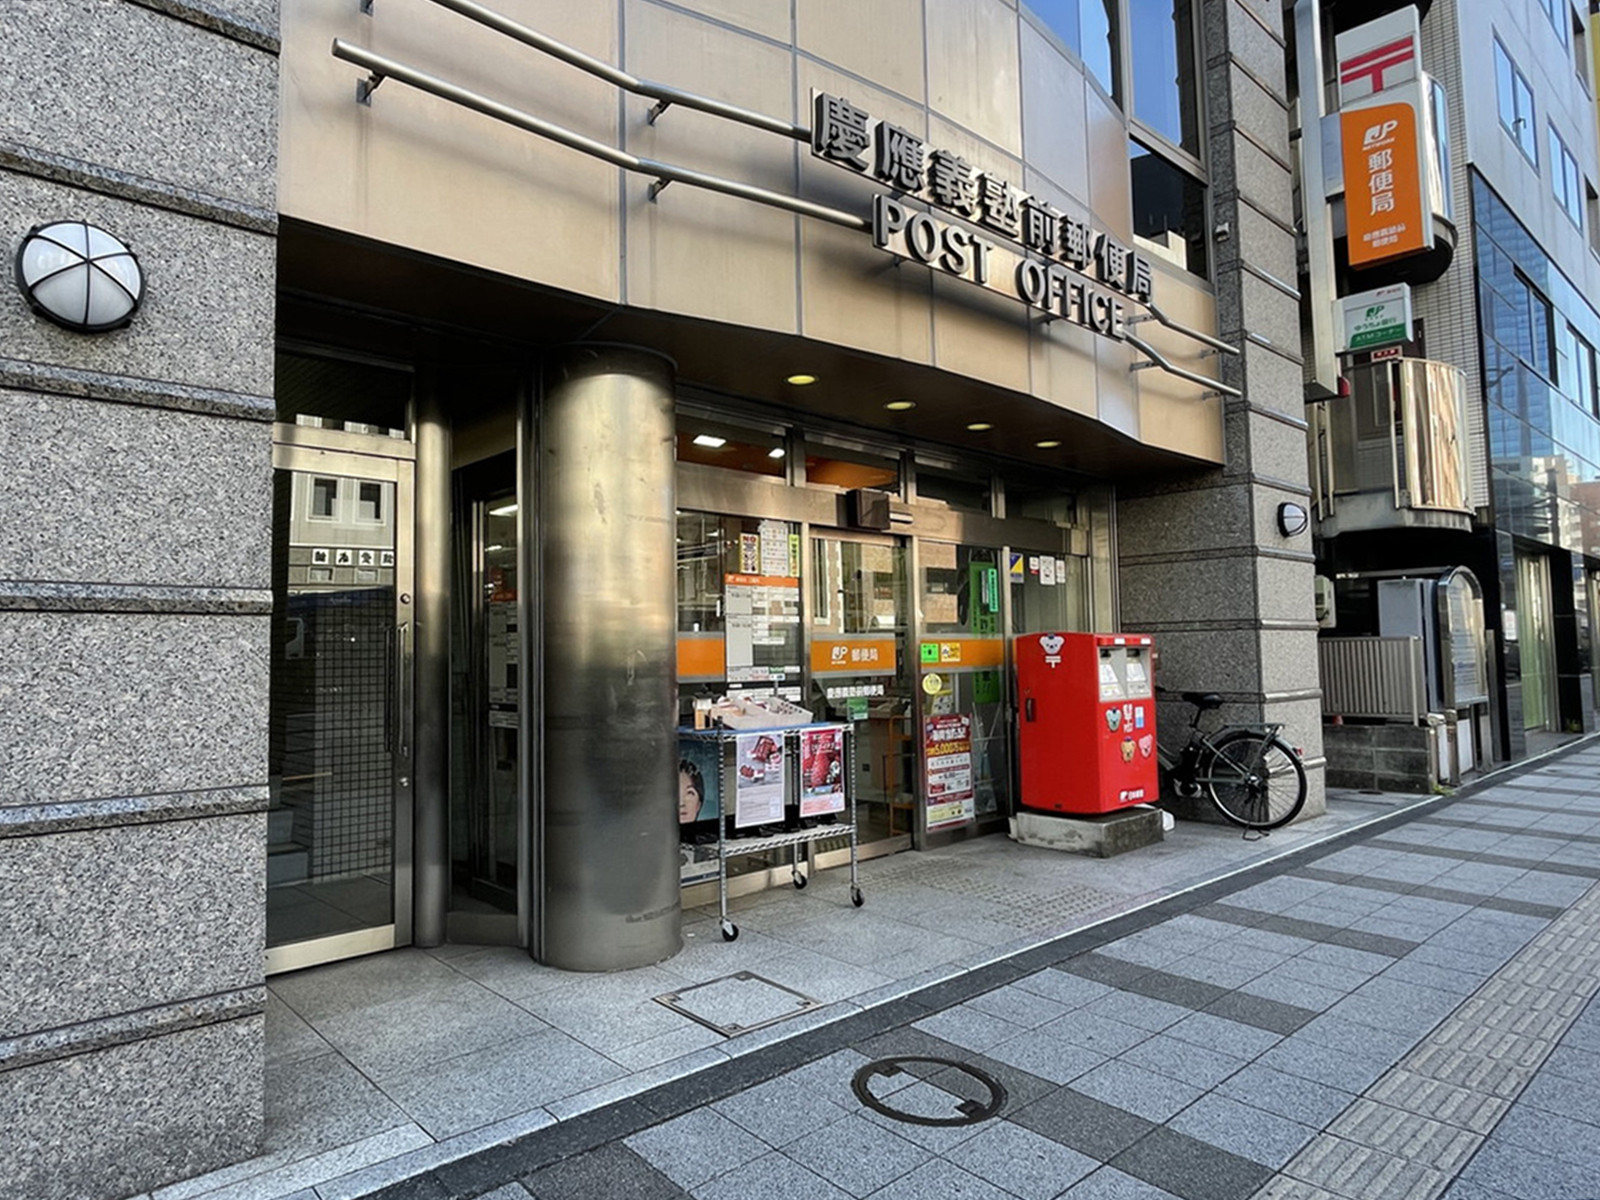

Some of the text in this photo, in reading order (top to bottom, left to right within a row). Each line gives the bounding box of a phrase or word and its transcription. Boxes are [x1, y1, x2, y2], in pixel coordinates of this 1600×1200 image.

[814, 91, 1153, 302] 慶應義塾前郵便局
[1368, 148, 1394, 216] 郵便局
[875, 194, 1125, 338] POST OFFICE
